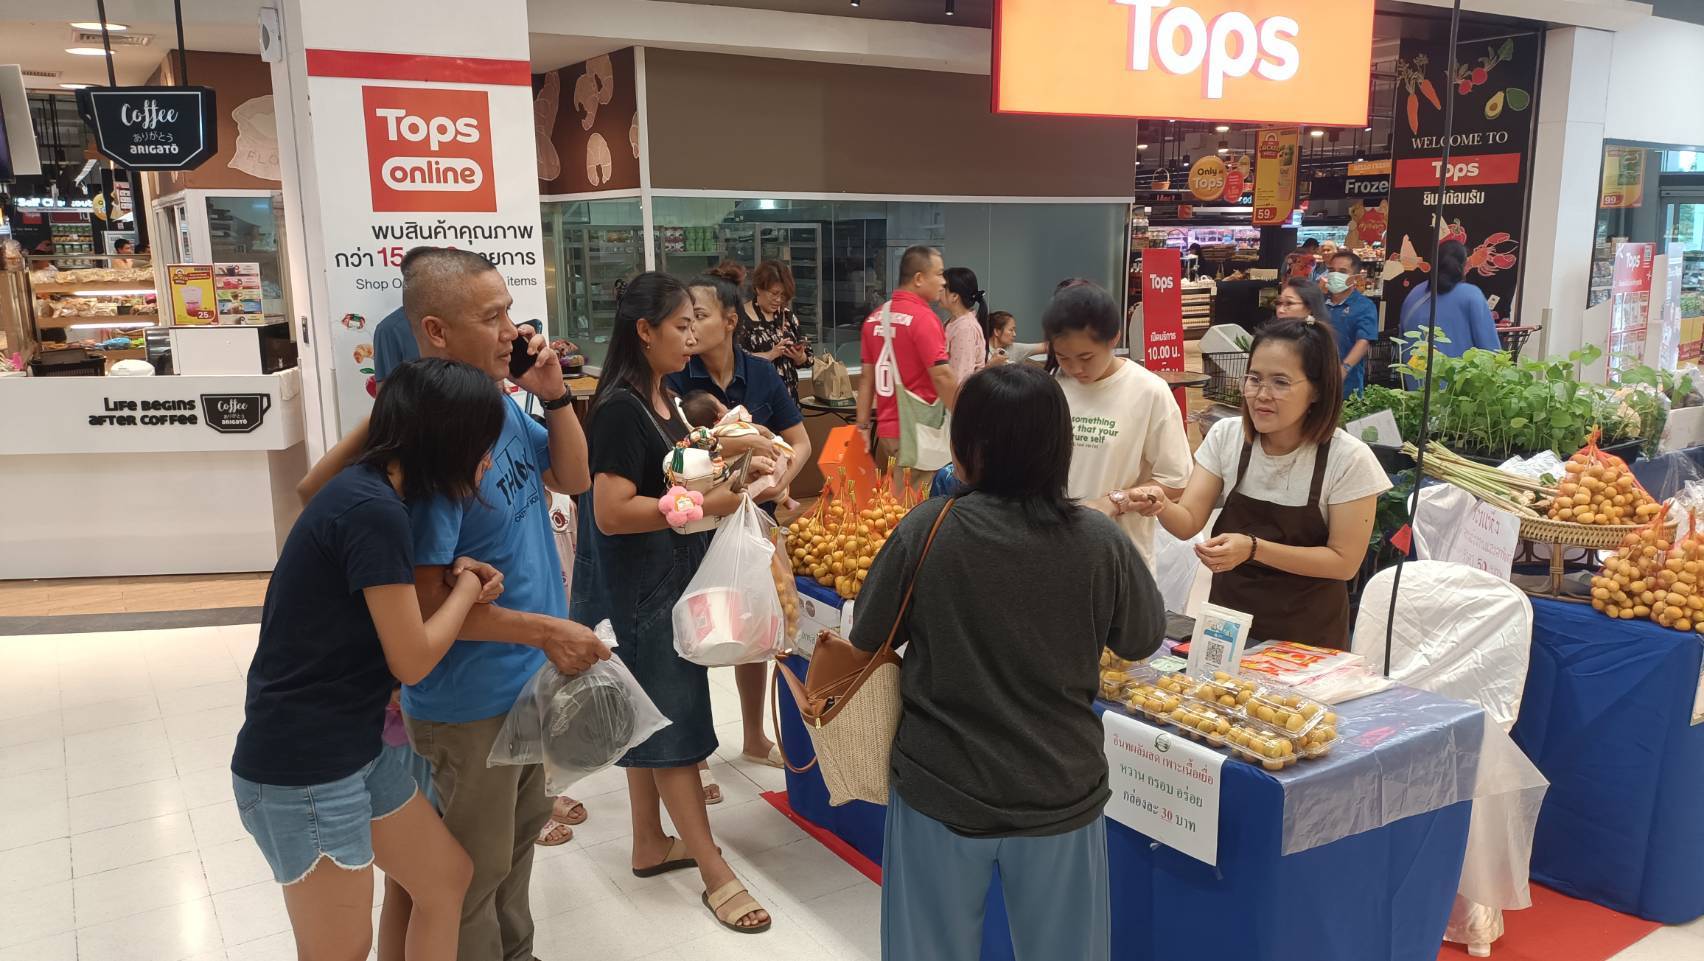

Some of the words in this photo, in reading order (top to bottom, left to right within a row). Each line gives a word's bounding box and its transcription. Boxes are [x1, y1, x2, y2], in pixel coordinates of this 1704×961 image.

[1115, 0, 1300, 99] Tops
[121, 100, 178, 129] Coffee
[133, 131, 174, 142] ありがとう
[376, 108, 480, 151] Tops
[1486, 131, 1508, 144] TO
[389, 160, 476, 184] online
[1197, 168, 1218, 177] Only
[1431, 161, 1479, 181] Tops
[1194, 177, 1224, 190] Tops
[1344, 179, 1390, 194] Froze
[1257, 209, 1271, 219] 59
[371, 219, 534, 245] พบสินค้าคุณภาพ
[335, 247, 375, 268] กว่า
[356, 278, 389, 292] Shop
[507, 275, 538, 287] items
[1149, 273, 1174, 293] Tops
[1147, 345, 1170, 360] 10.00
[217, 399, 248, 413] Coffee
[1072, 416, 1116, 429] something
[1077, 424, 1097, 434] that
[1099, 428, 1120, 437] your
[1091, 435, 1106, 444] self
[1120, 763, 1146, 783] หวาน
[1148, 776, 1175, 796] กรอบ
[1176, 785, 1204, 808] อร่อย
[1122, 788, 1160, 816] กล่องละ
[1160, 807, 1174, 823] 30
[1175, 814, 1197, 834] บาท
